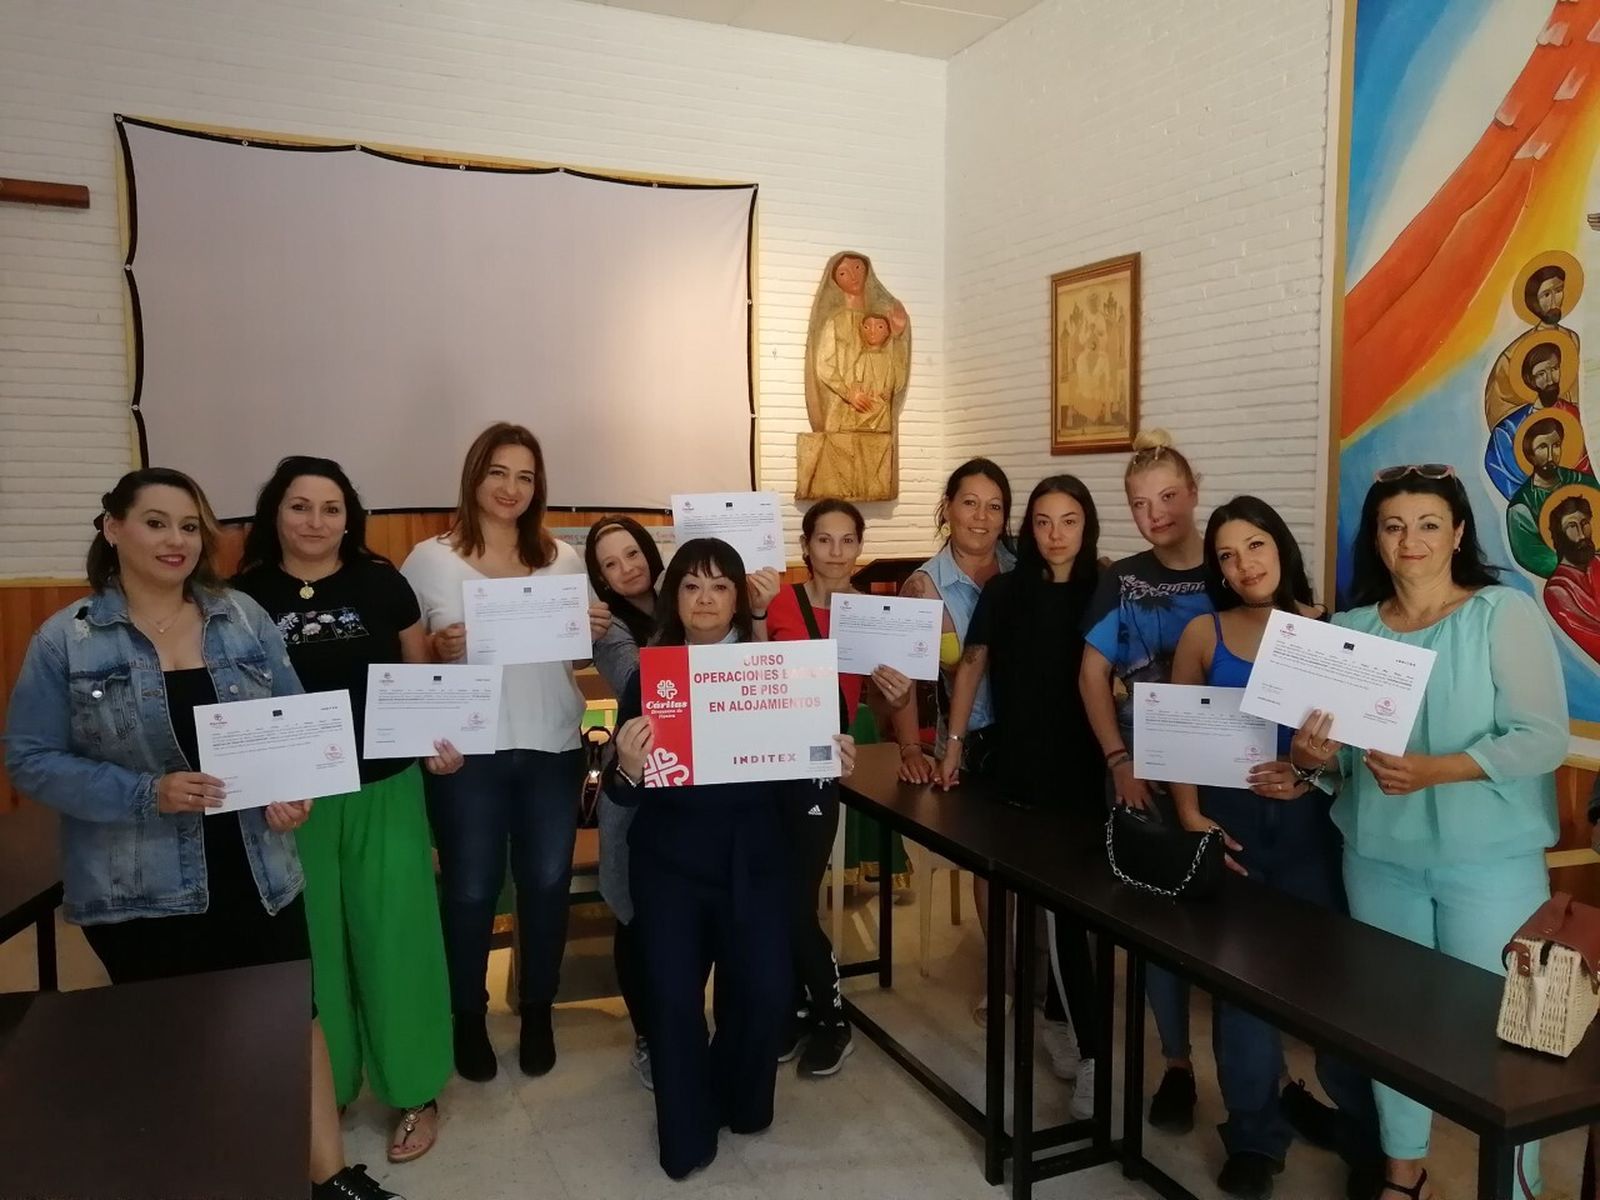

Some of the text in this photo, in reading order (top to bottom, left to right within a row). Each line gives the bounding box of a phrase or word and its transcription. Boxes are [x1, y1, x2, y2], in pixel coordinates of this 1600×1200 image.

[694, 669, 779, 684] OPERACIONES
[741, 683, 788, 696] DE PISO
[646, 700, 688, 710] Cáritas
[709, 696, 821, 713] EN ALOJAMIENTOS
[733, 753, 796, 765] INDITEX
